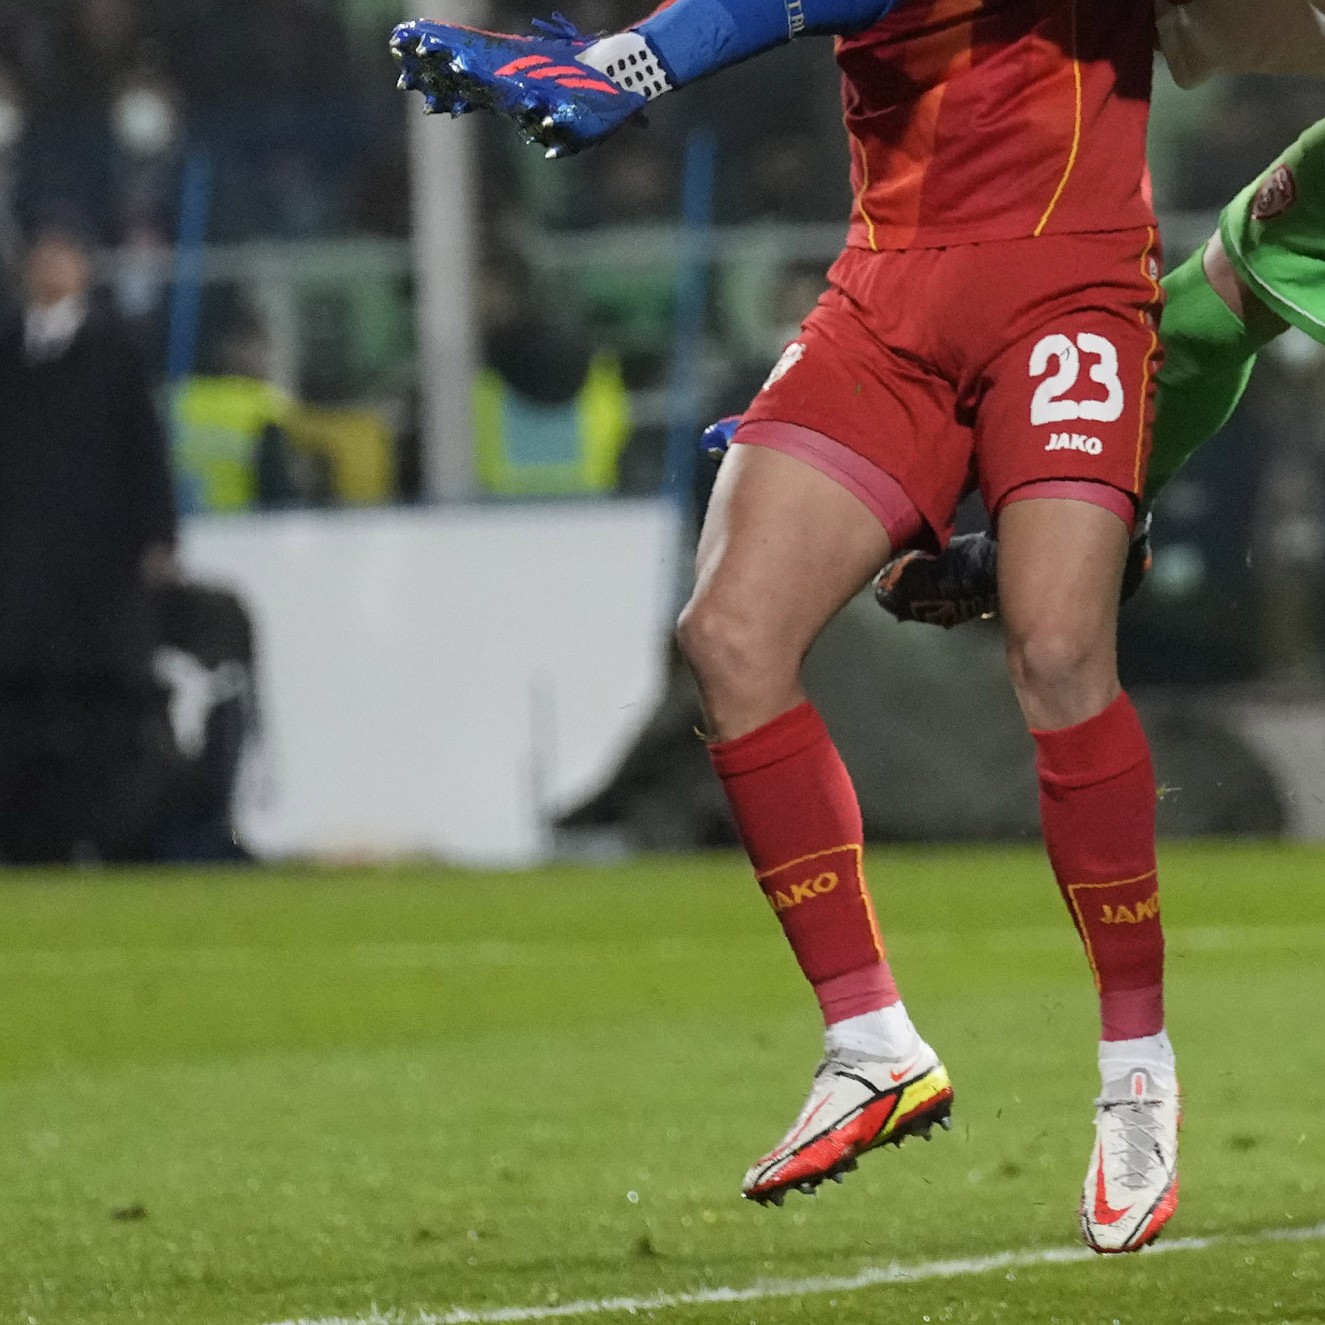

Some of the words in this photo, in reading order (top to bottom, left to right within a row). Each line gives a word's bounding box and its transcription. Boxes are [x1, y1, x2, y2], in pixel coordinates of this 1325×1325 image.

[1028, 332, 1124, 426] 23
[1044, 432, 1103, 455] JAKO
[768, 872, 839, 910] AKO
